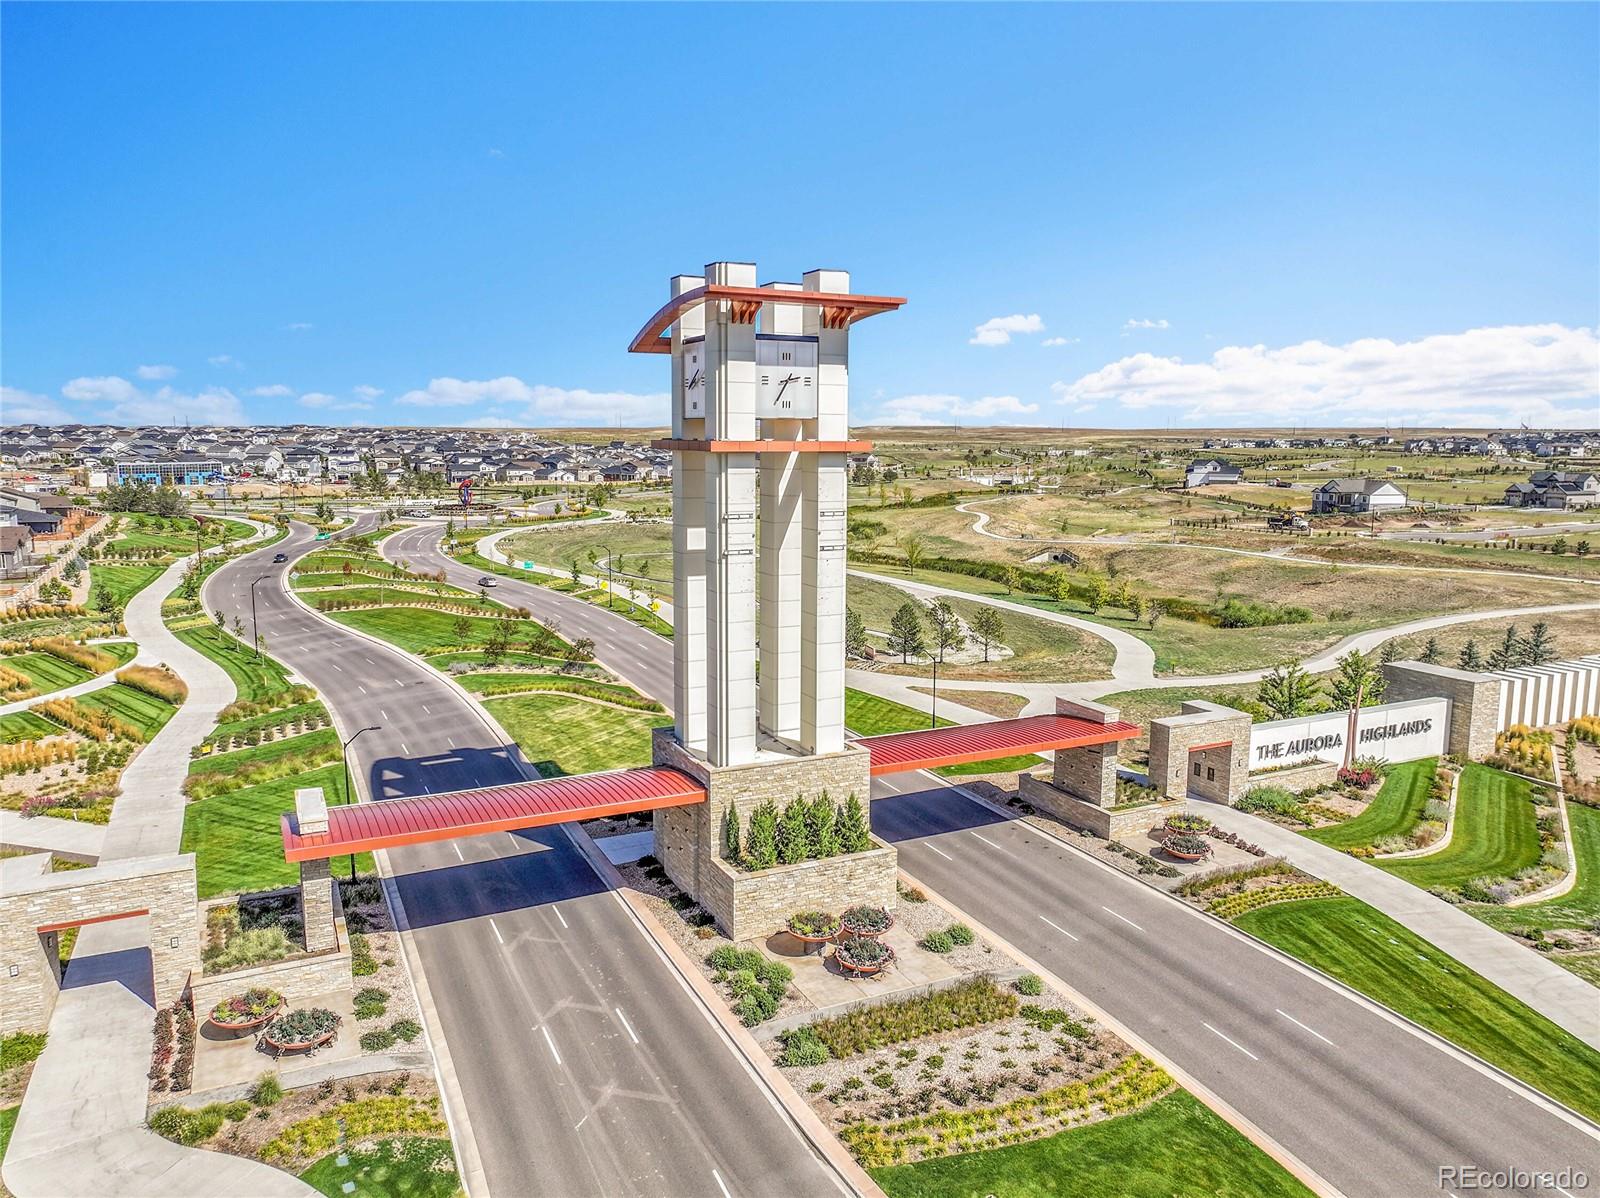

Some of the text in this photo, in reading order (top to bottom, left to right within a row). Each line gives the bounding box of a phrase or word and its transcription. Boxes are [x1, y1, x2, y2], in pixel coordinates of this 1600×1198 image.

[1256, 718, 1432, 761] THE AURORA HIGHLANDS
